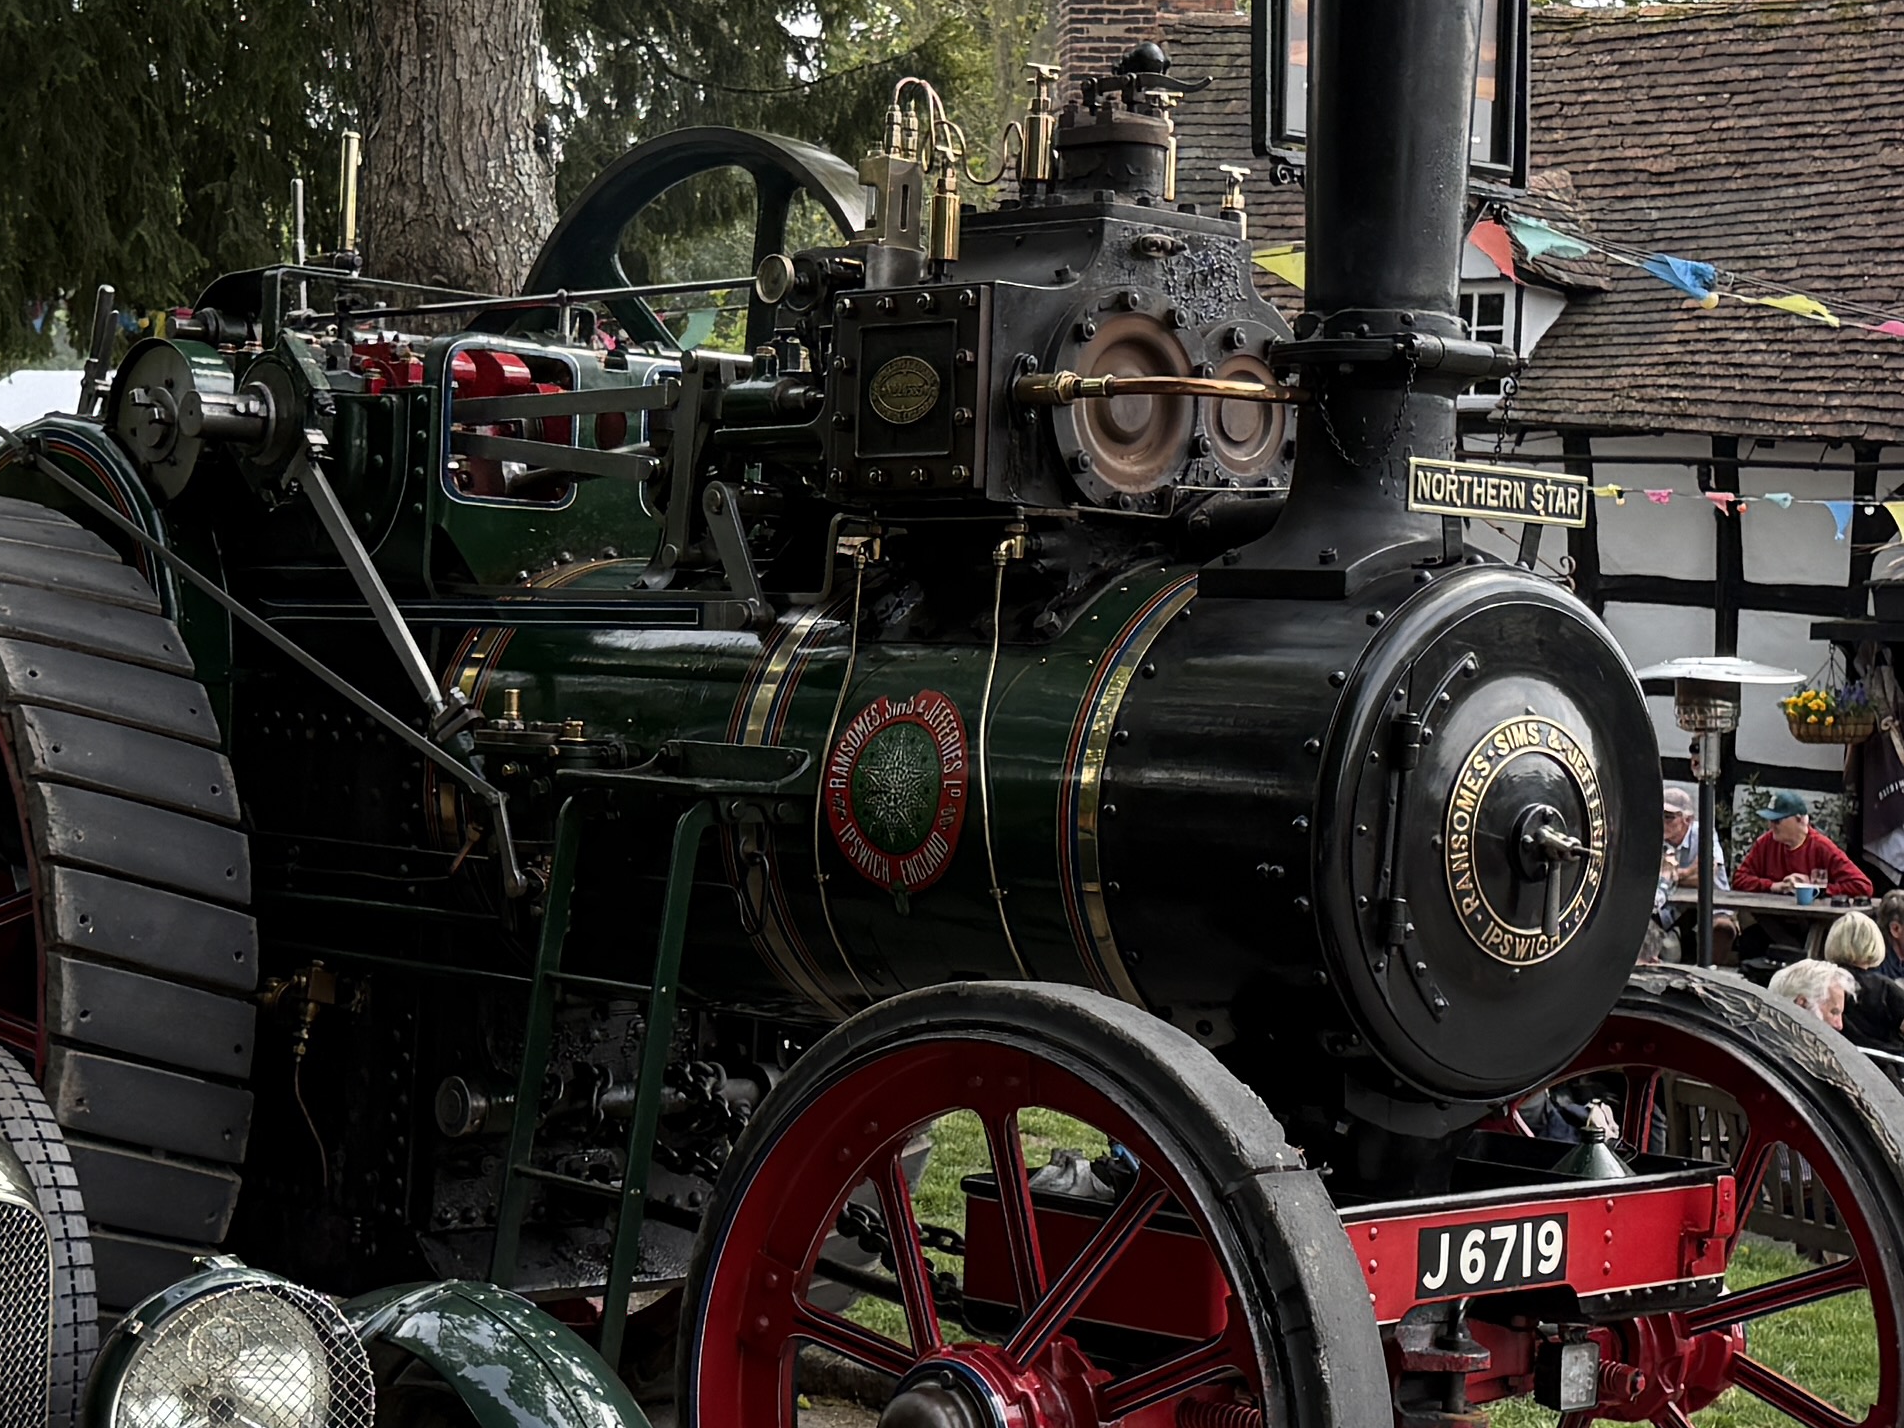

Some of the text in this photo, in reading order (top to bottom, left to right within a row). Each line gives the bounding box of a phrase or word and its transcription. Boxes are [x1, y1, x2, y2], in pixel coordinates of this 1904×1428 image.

[1417, 470, 1580, 515] NORTHERN STAR
[1450, 755, 1491, 916] RANSOMES
[1493, 723, 1541, 757] SIMS
[839, 822, 949, 886] IPSWICH ENGLAND
